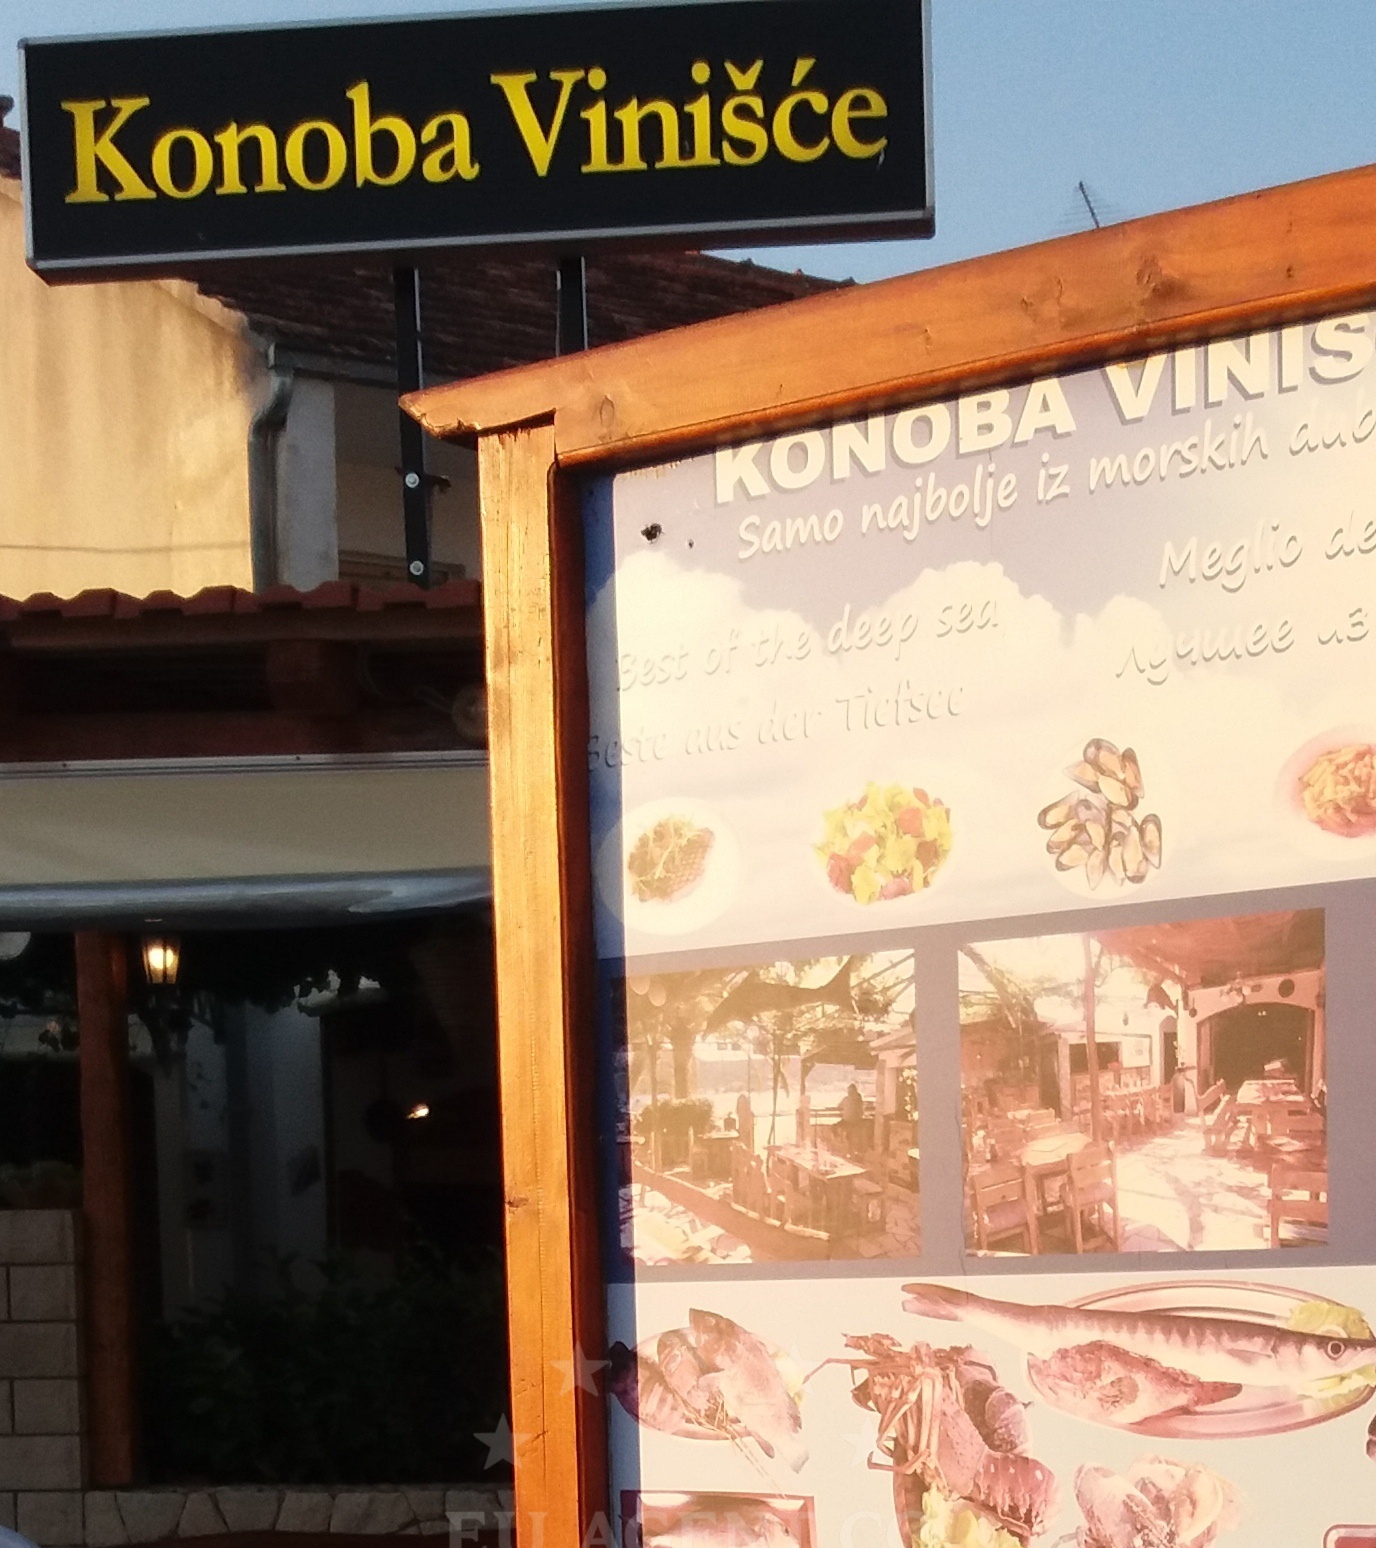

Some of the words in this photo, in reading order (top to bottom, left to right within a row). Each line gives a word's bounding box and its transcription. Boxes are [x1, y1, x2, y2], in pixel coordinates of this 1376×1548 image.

[60, 79, 480, 205] Konoba
[490, 57, 890, 178] Vinišće
[714, 377, 1078, 505] KONOBA
[735, 496, 845, 561] Samo
[860, 461, 1020, 543] najbolje
[1035, 450, 1072, 502] iz
[1088, 411, 1270, 494] morskih
[1158, 519, 1304, 594] Meglio
[826, 602, 920, 662] deep
[936, 598, 1000, 639] sea
